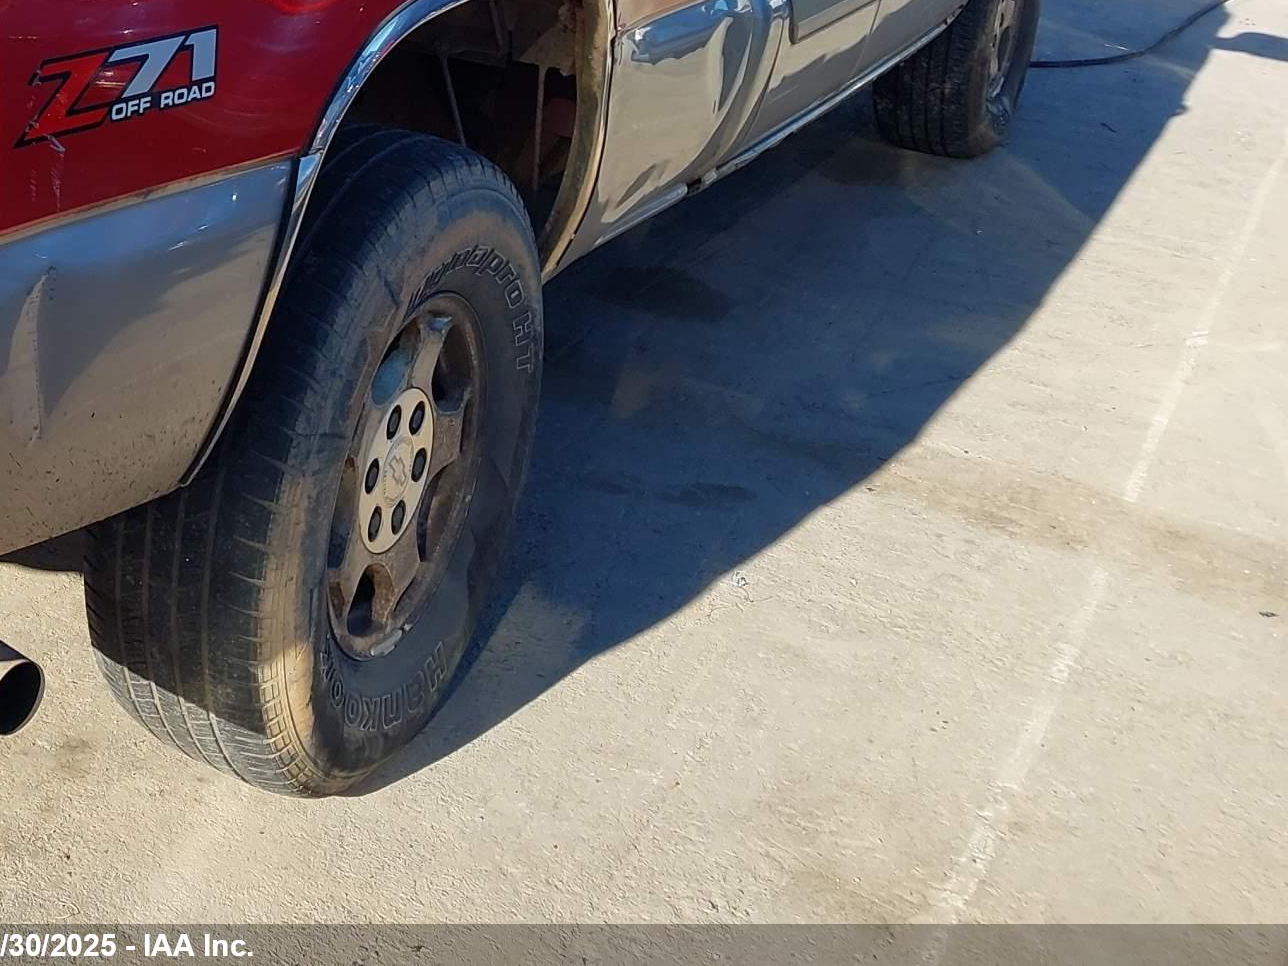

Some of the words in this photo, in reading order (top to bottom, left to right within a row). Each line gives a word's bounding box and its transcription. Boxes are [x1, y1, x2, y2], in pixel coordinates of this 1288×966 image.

[14, 25, 218, 149] Z71
[111, 97, 151, 121] OFF
[160, 82, 215, 108] ROAD
